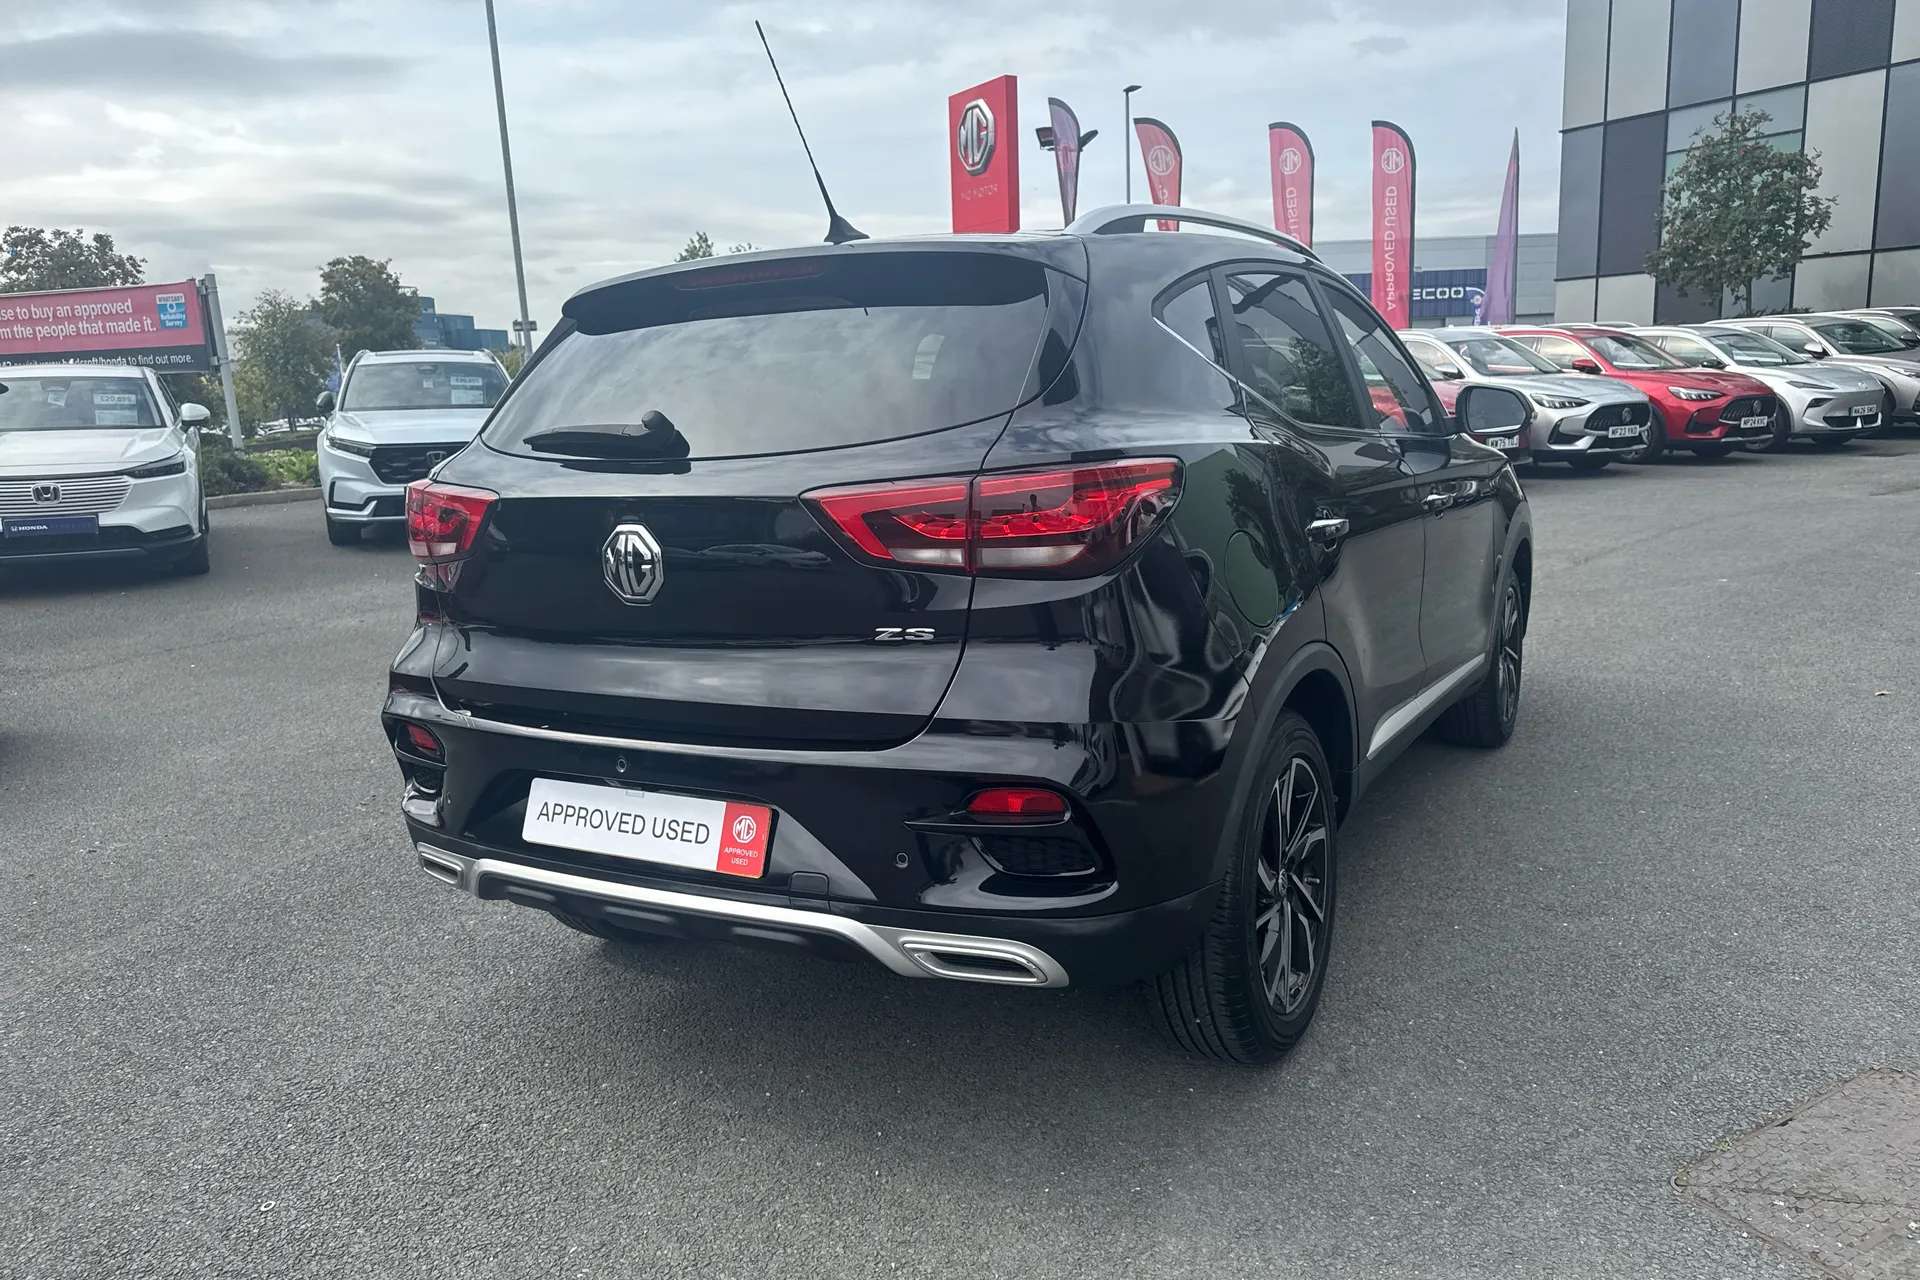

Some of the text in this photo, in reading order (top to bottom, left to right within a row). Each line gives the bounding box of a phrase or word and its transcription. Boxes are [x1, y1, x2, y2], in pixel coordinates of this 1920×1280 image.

[960, 105, 989, 167] MG
[0, 298, 132, 321] se to buy an approved
[14, 324, 33, 338] the
[36, 321, 76, 341] people
[78, 320, 104, 335] that
[106, 318, 141, 334] made
[143, 316, 156, 332] it.
[128, 356, 136, 365] to
[138, 354, 153, 365] find
[155, 354, 169, 364] out
[170, 353, 193, 364] more.
[604, 530, 656, 600] MG
[874, 627, 936, 641] ZS
[537, 801, 710, 845] APPROVED USED
[734, 817, 755, 842] MG
[724, 847, 758, 857] APPROVED
[731, 857, 748, 866] USED
